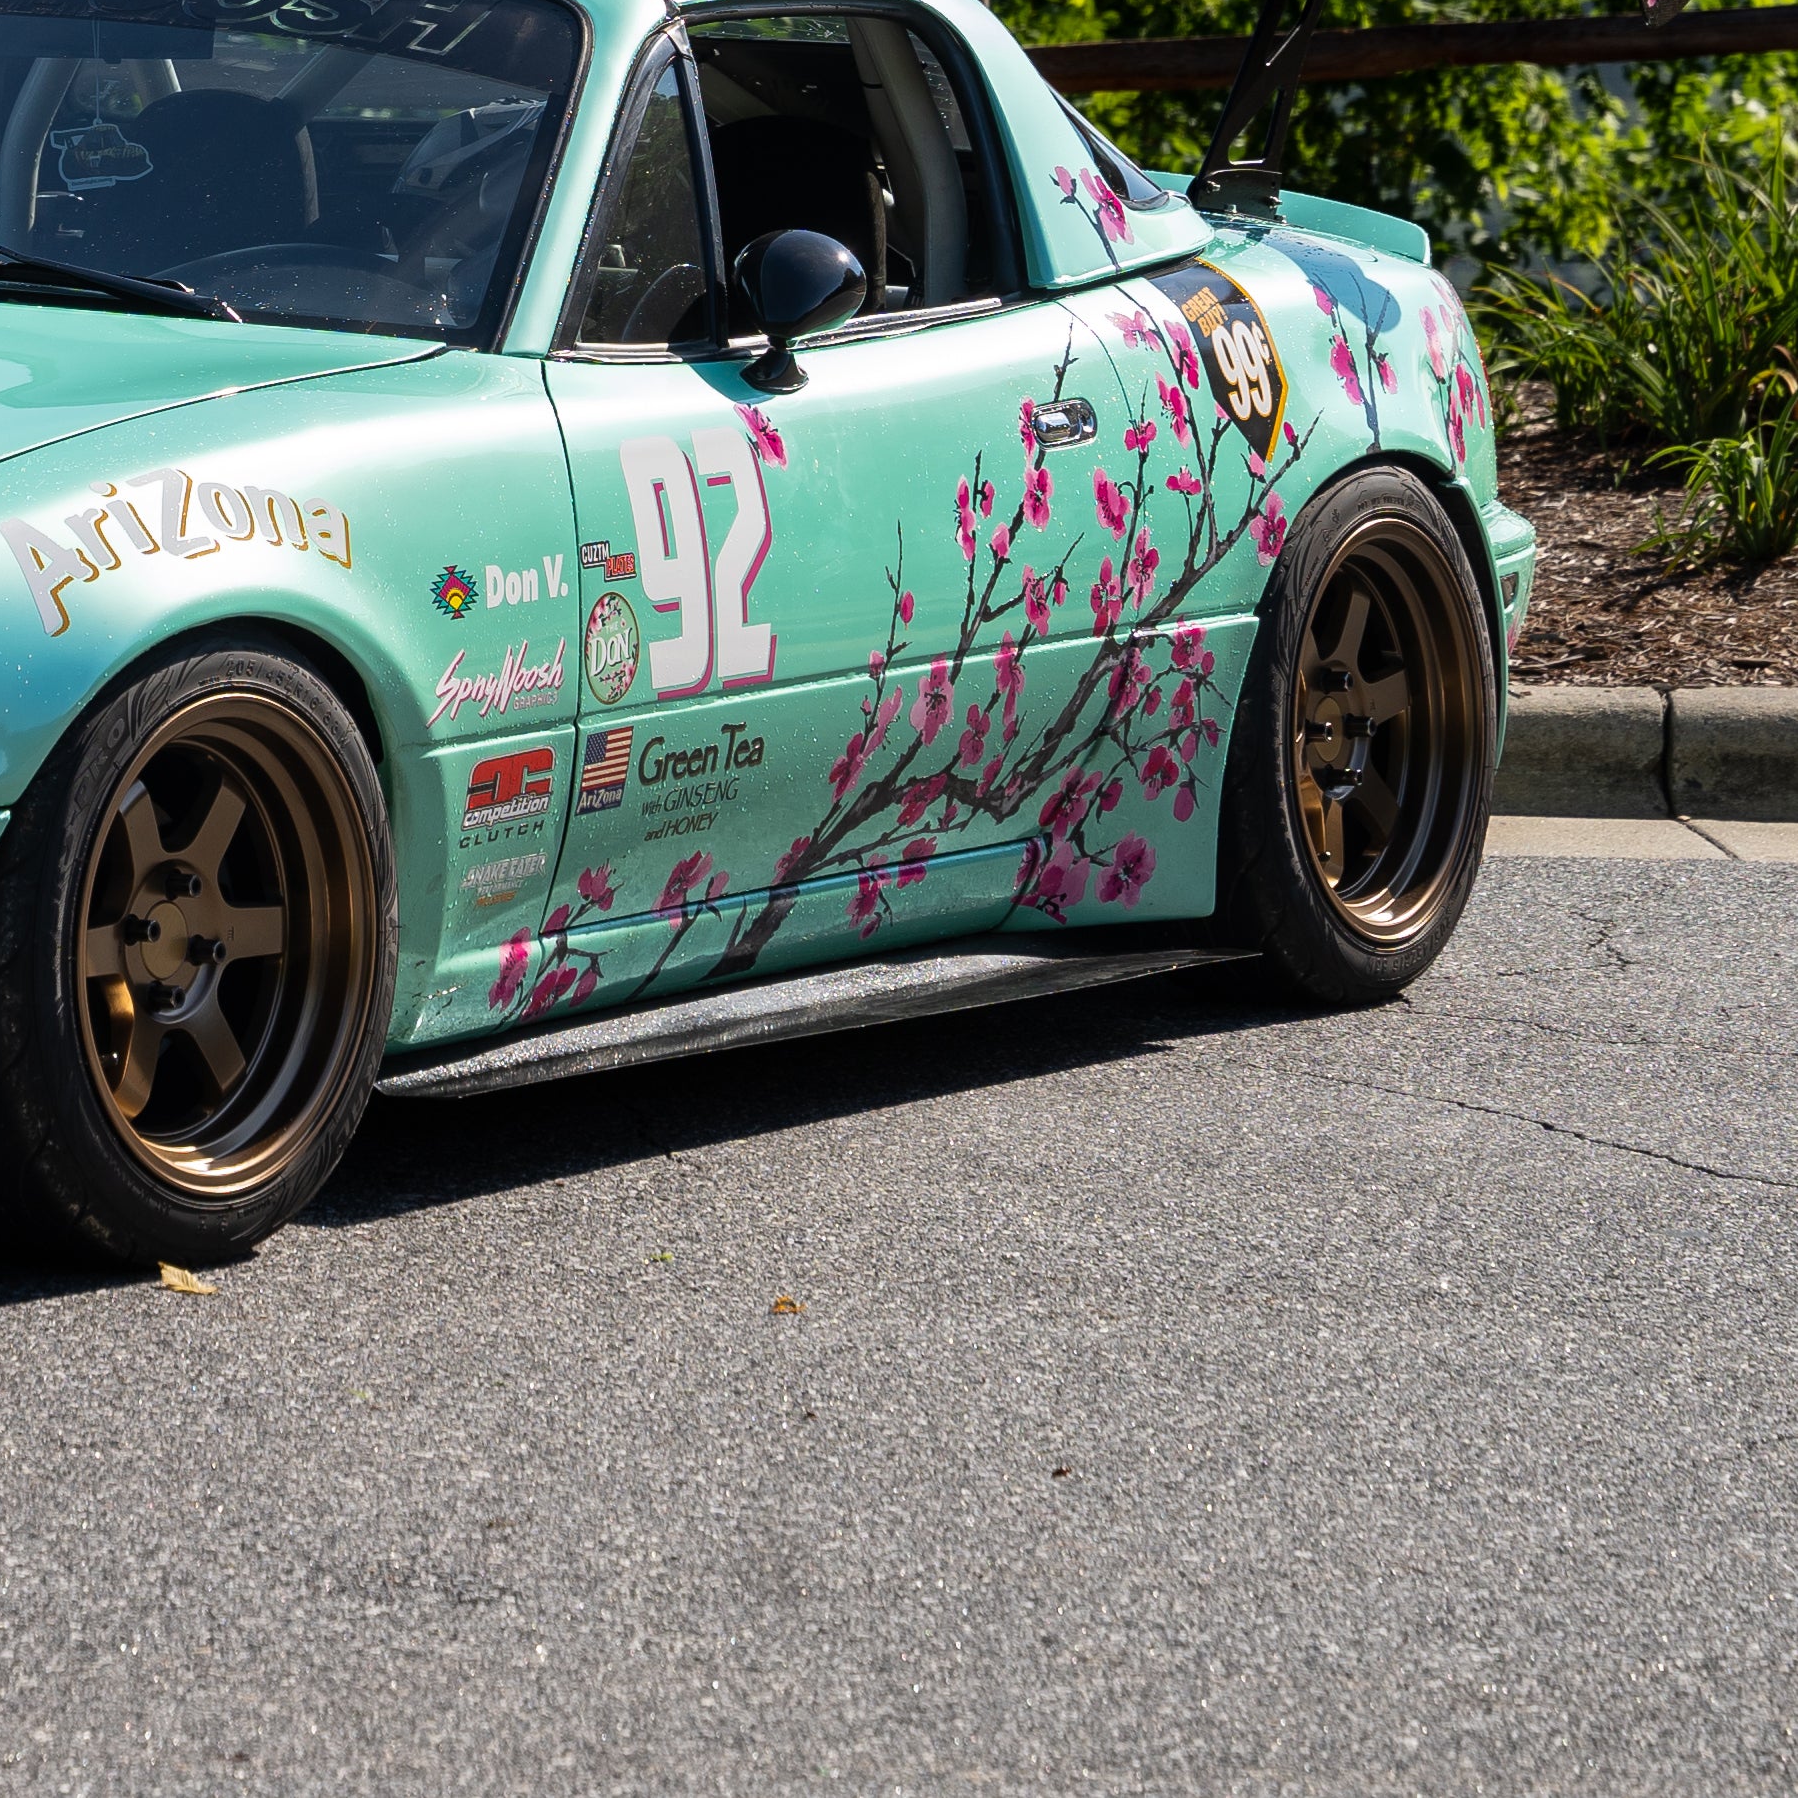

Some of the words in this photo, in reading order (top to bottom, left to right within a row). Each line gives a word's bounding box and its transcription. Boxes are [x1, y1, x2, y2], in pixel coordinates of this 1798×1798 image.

[1182, 286, 1219, 323] GREAT
[1197, 304, 1229, 338] BUY!
[605, 554, 635, 577] PLATES
[619, 426, 778, 701] 92
[485, 564, 539, 610] Don
[542, 553, 569, 599] V.
[513, 690, 558, 711] GRAPHICS
[638, 736, 719, 786] Green
[721, 721, 765, 771] Tea
[463, 794, 550, 827] competition
[576, 788, 623, 814] AriZona
[663, 777, 740, 812] GINSENG
[459, 819, 546, 850] CLUTCH
[663, 812, 719, 839] HONEY
[461, 859, 511, 889] SNAKE
[510, 853, 547, 878] EATER
